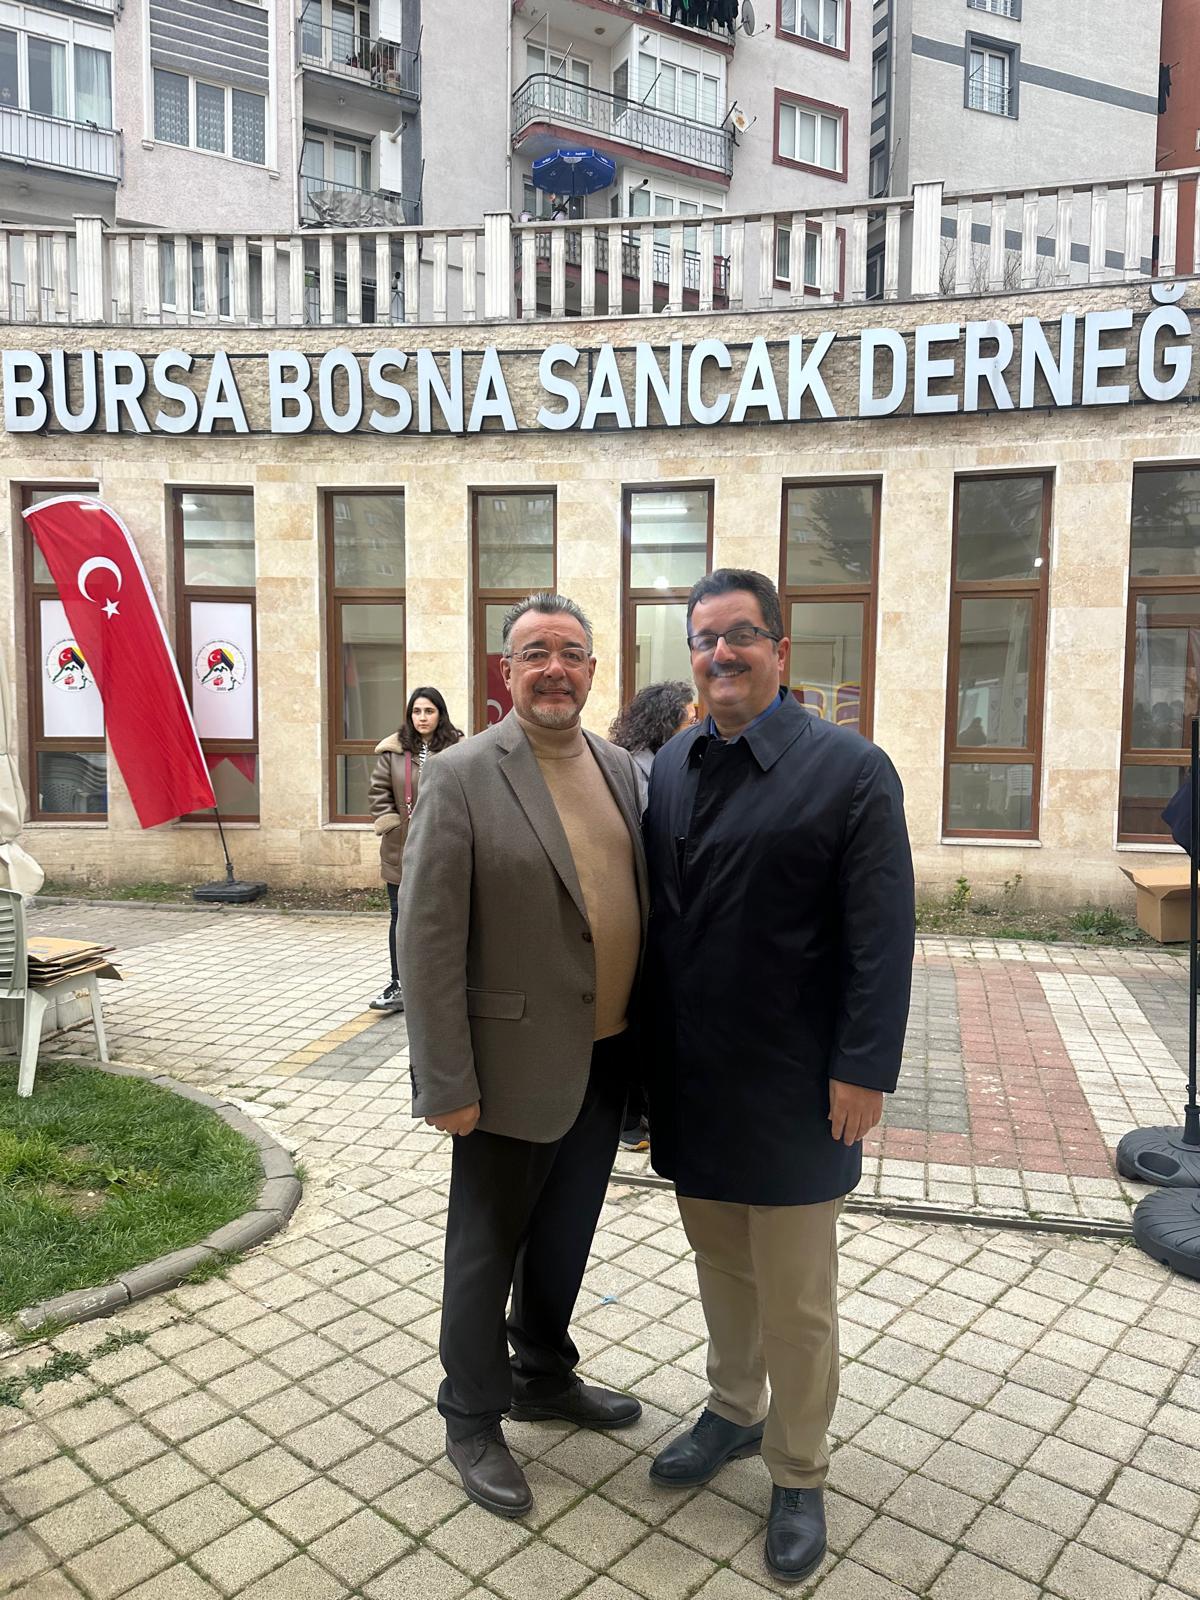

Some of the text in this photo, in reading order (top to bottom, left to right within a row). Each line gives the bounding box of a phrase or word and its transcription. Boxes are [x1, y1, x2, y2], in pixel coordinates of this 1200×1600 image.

[3, 282, 1192, 433] BURSA BOSNA SANCAK DERNEĞ
